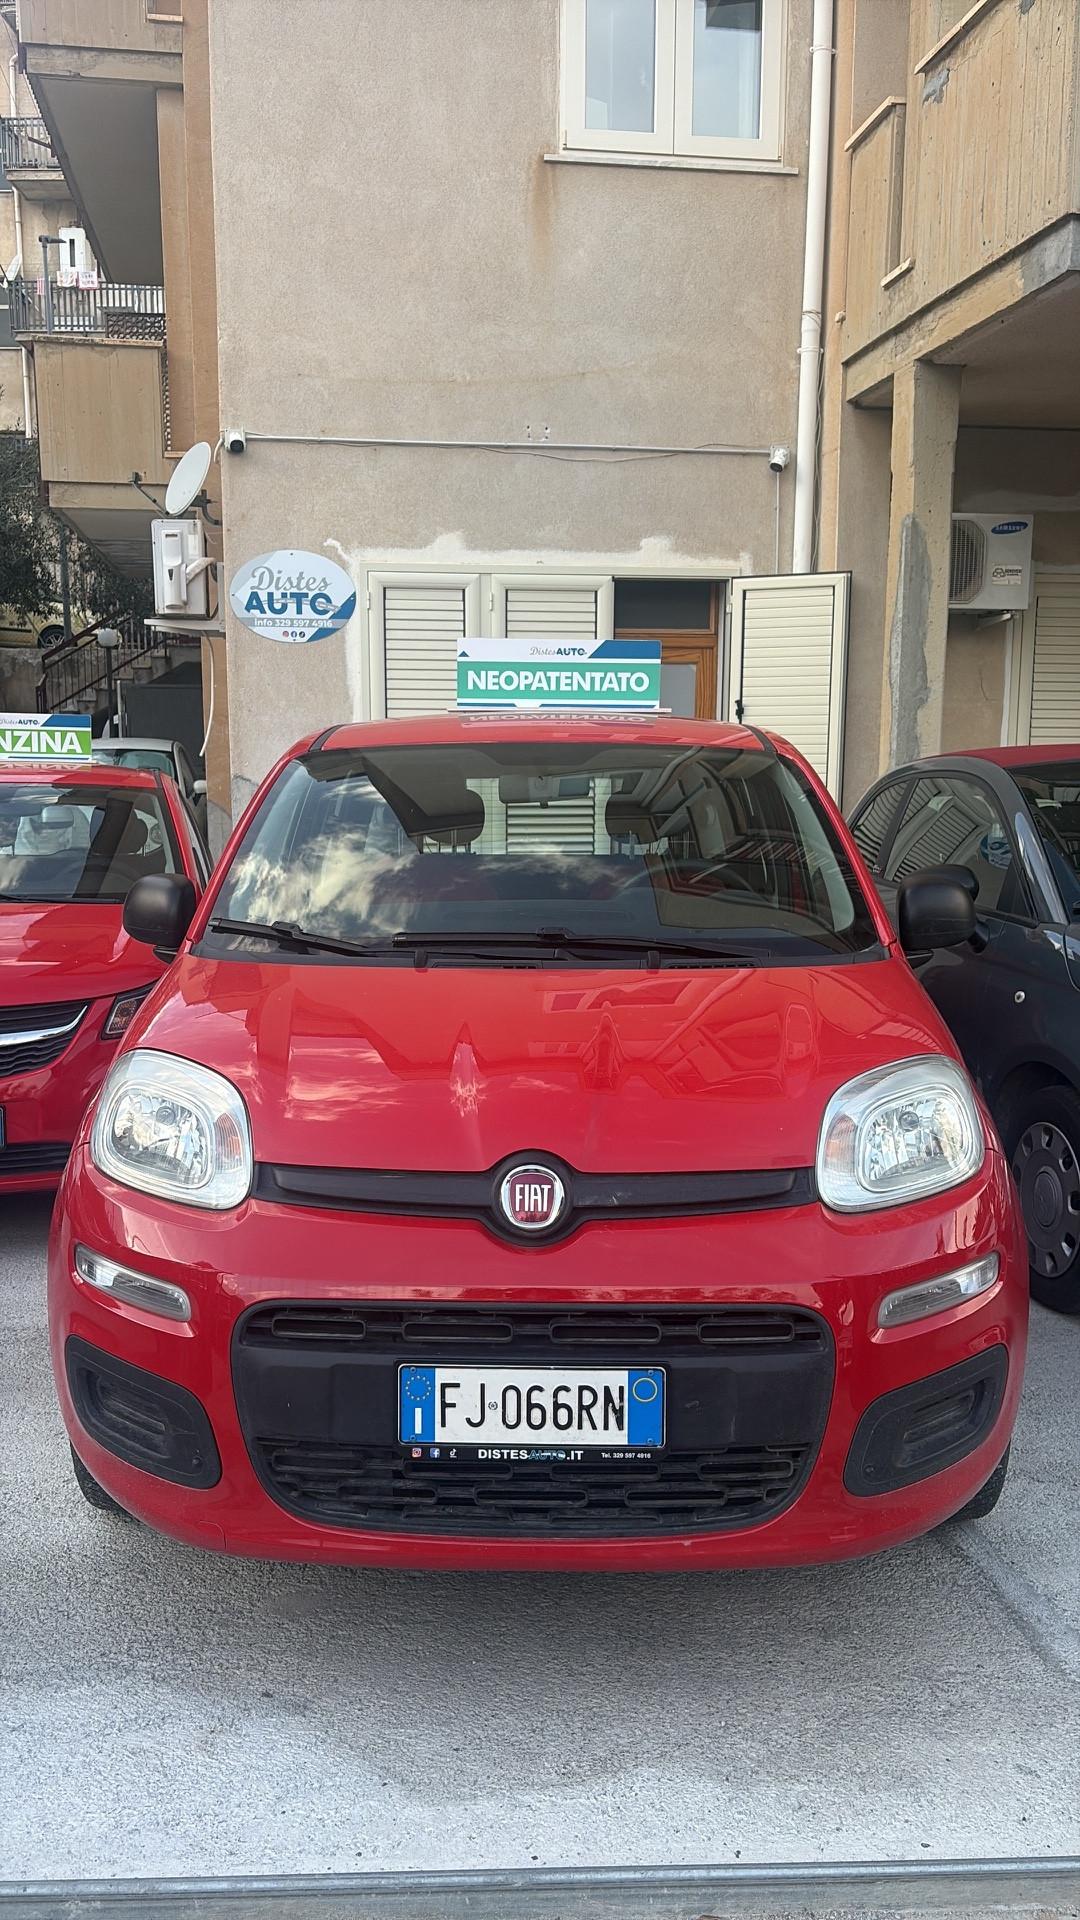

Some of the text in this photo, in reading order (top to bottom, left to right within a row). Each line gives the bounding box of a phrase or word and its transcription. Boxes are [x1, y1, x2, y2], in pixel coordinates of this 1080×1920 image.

[250, 566, 333, 592] Distes
[244, 591, 333, 616] AUTO
[274, 619, 291, 628] 329
[293, 619, 310, 628] 597
[311, 619, 333, 628] 4916
[467, 670, 650, 693] NEOPATENTATO
[515, 1183, 552, 1212] FIAT
[601, 1451, 612, 1459] Tel.
[612, 1451, 624, 1459] 329
